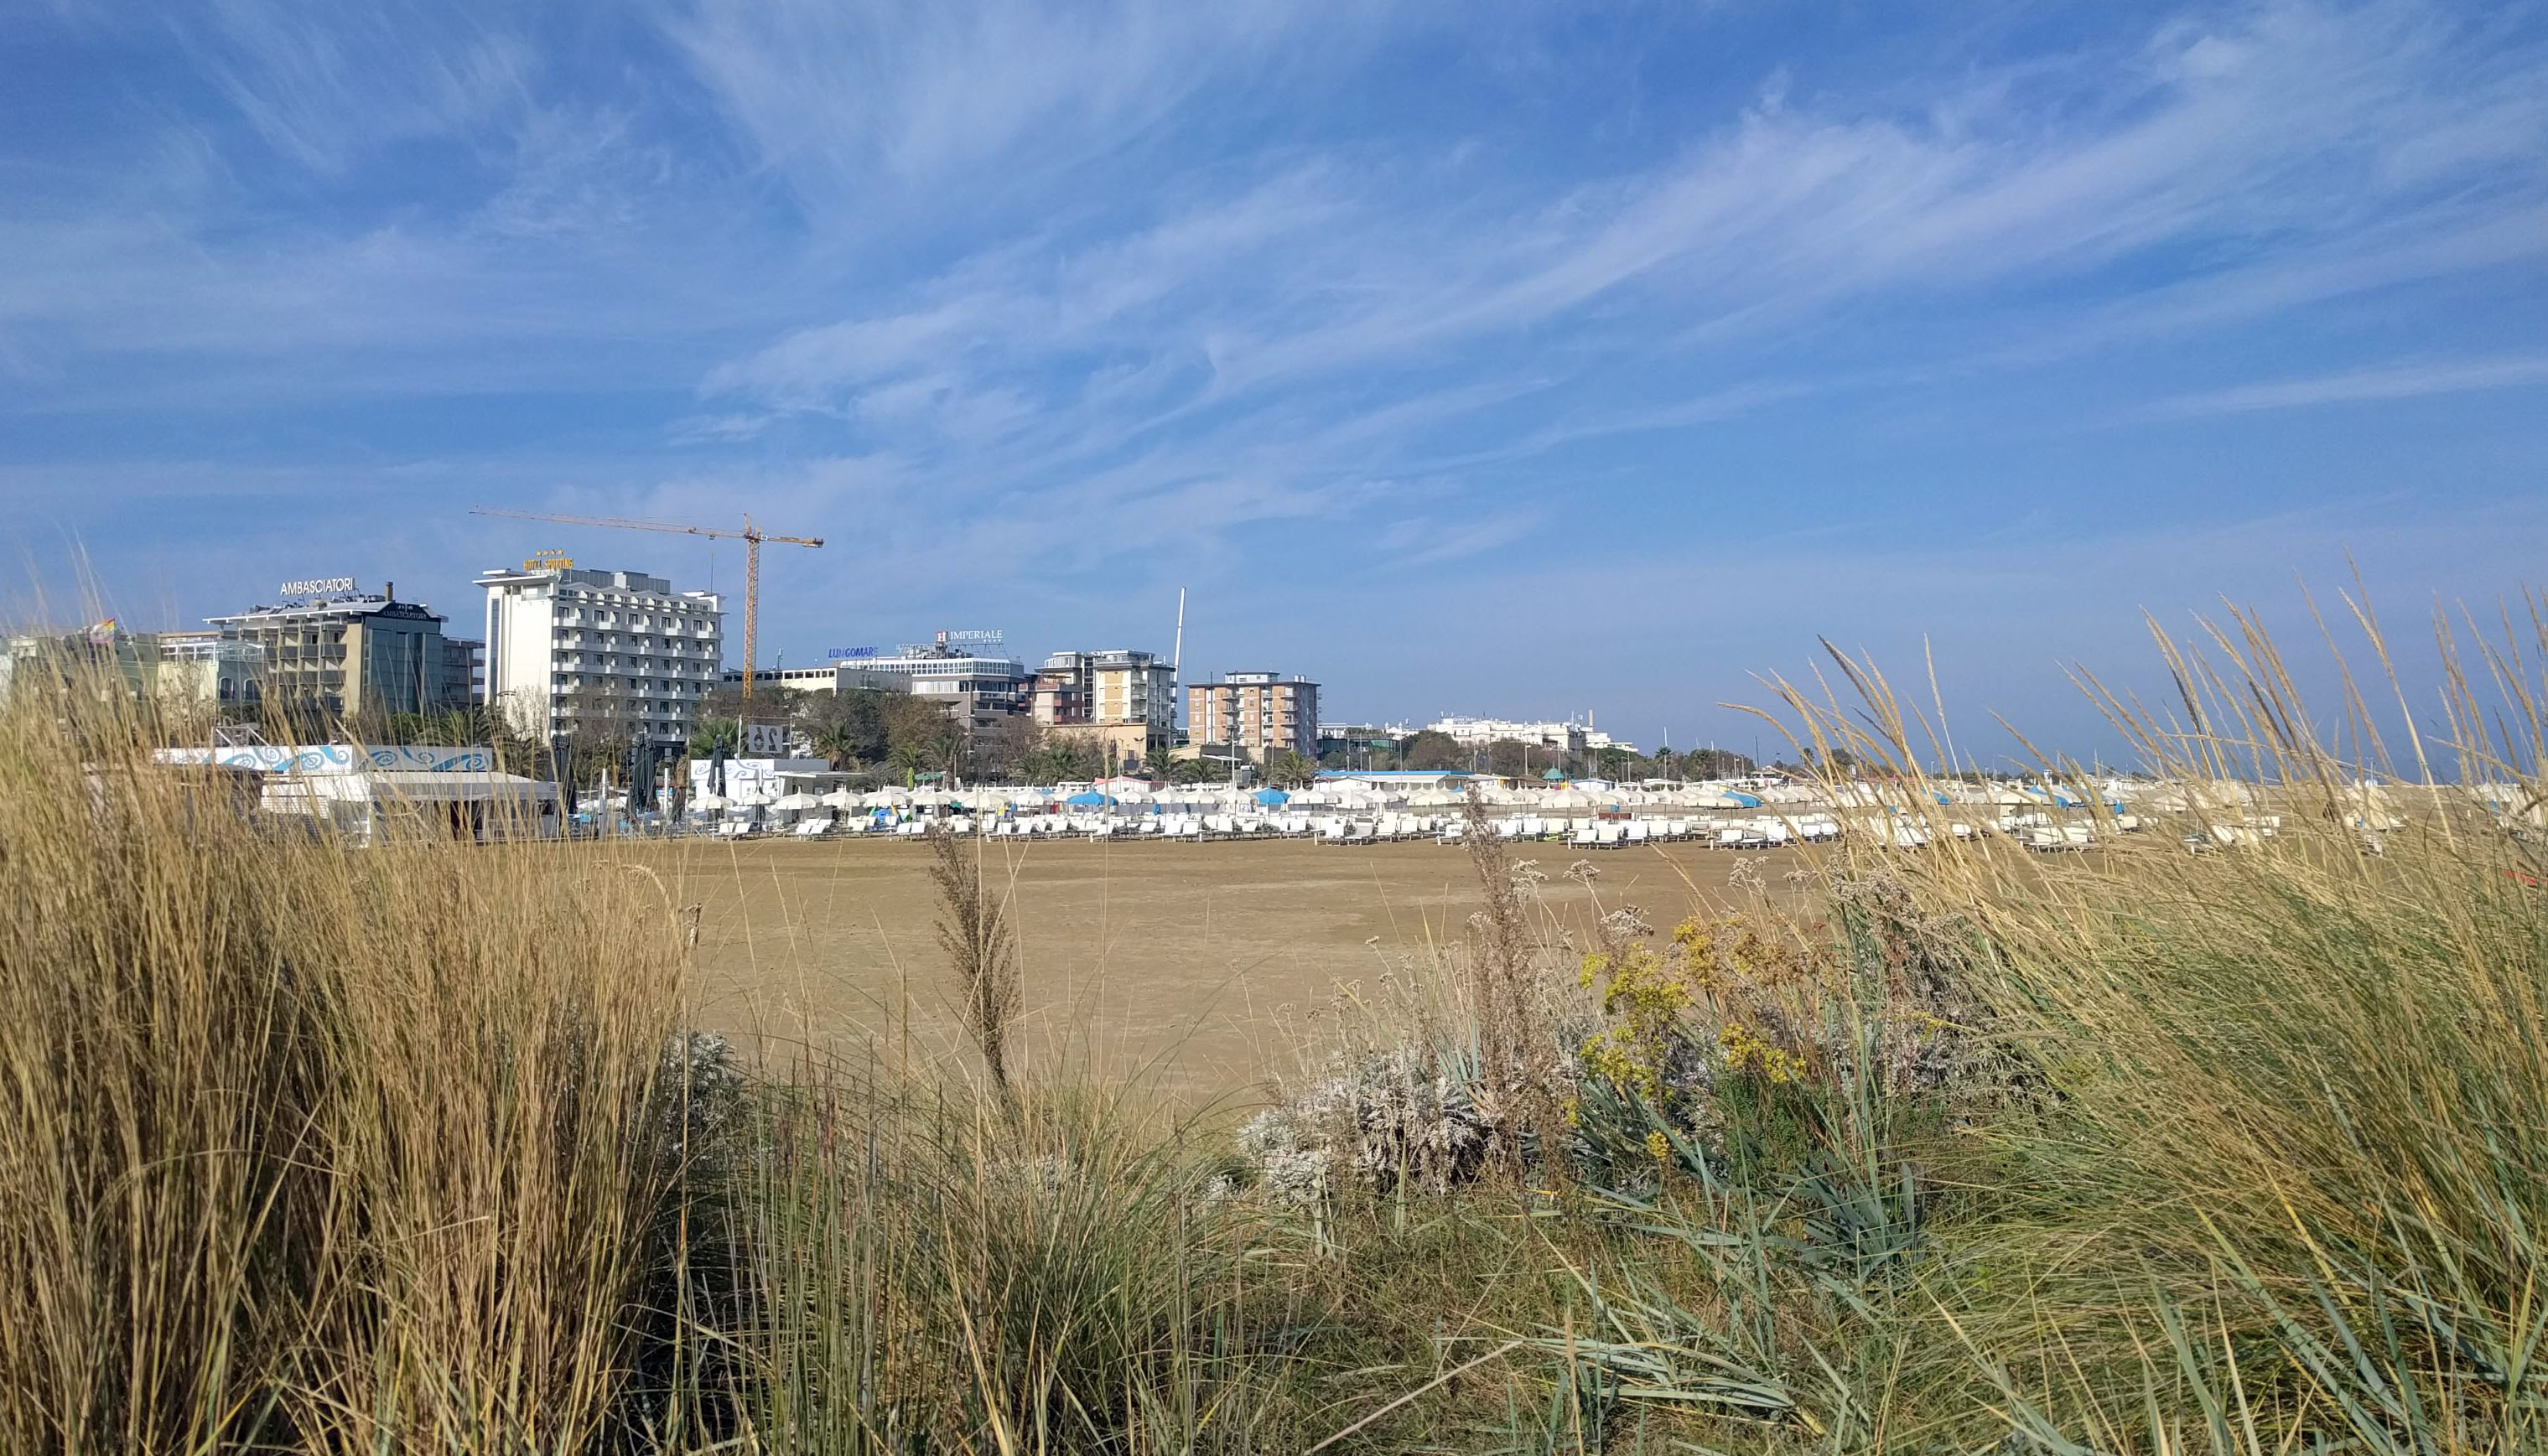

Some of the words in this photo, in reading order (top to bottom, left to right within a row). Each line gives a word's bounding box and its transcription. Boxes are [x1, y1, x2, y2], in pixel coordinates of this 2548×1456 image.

[545, 558, 573, 570] SPORTING
[281, 578, 353, 595] AMBASCIATORI
[950, 630, 1003, 640] IMPERIALE
